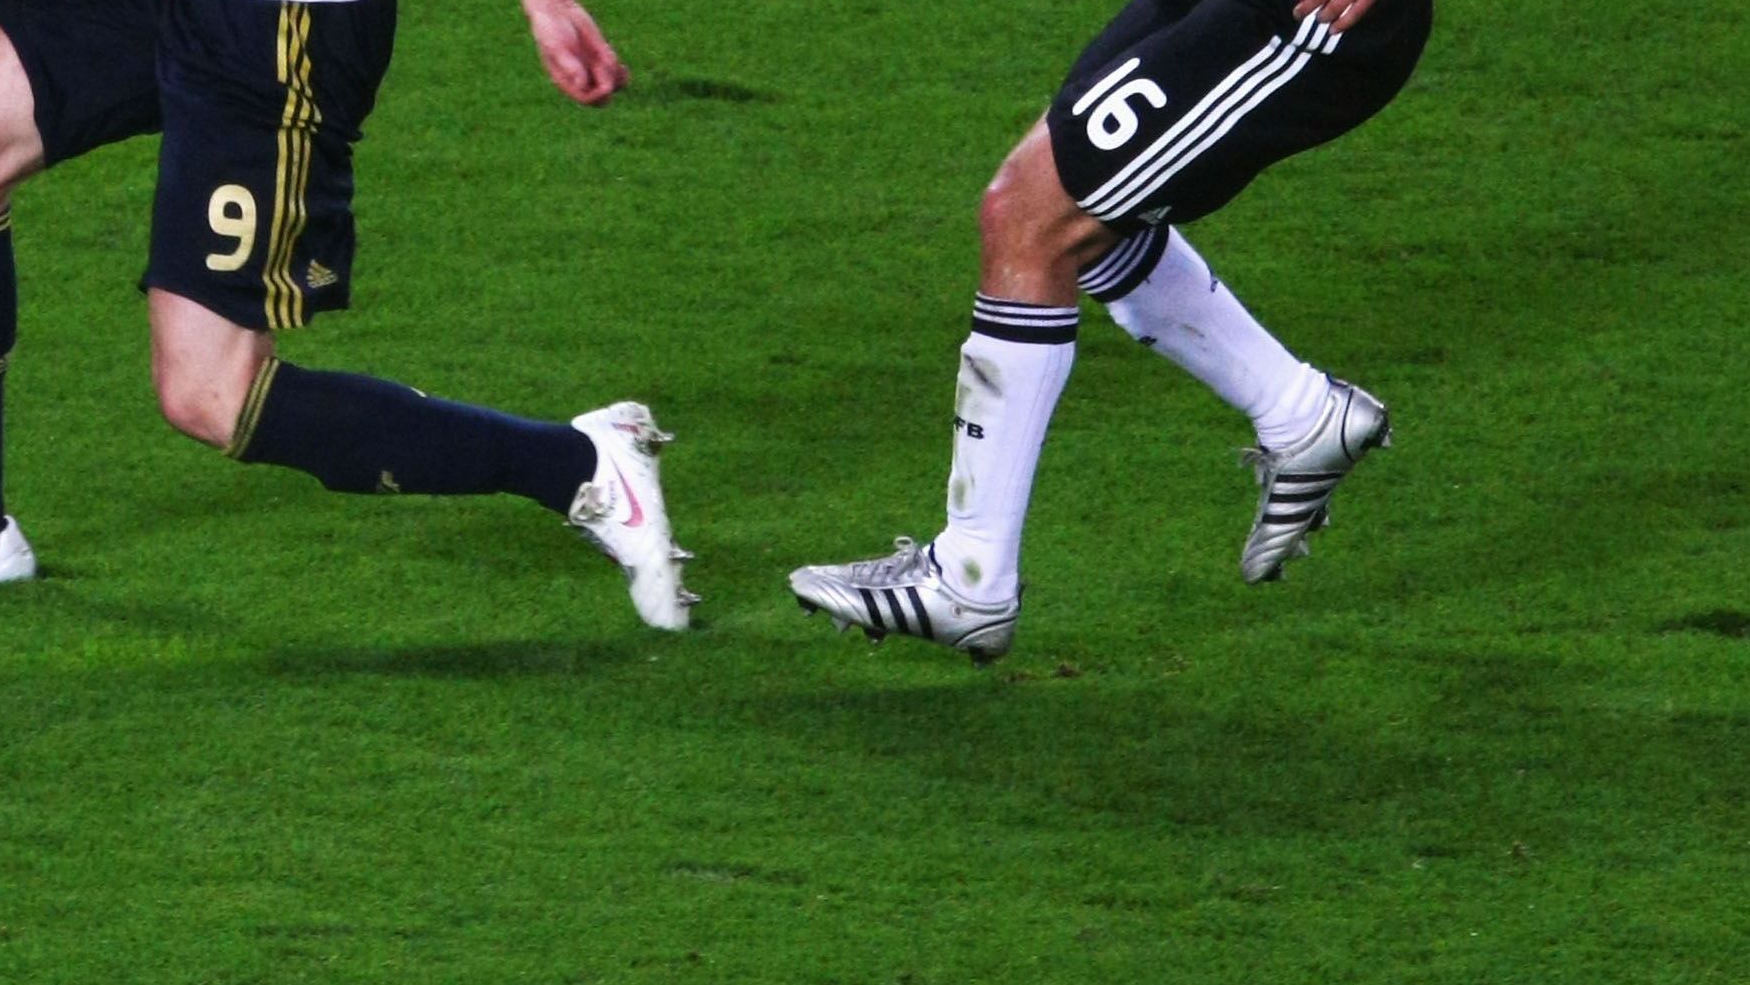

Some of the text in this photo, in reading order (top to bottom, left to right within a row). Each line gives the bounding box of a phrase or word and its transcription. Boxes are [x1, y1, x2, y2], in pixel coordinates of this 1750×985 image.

[1072, 57, 1168, 151] 16
[205, 183, 258, 272] 9
[953, 415, 985, 440] FB
